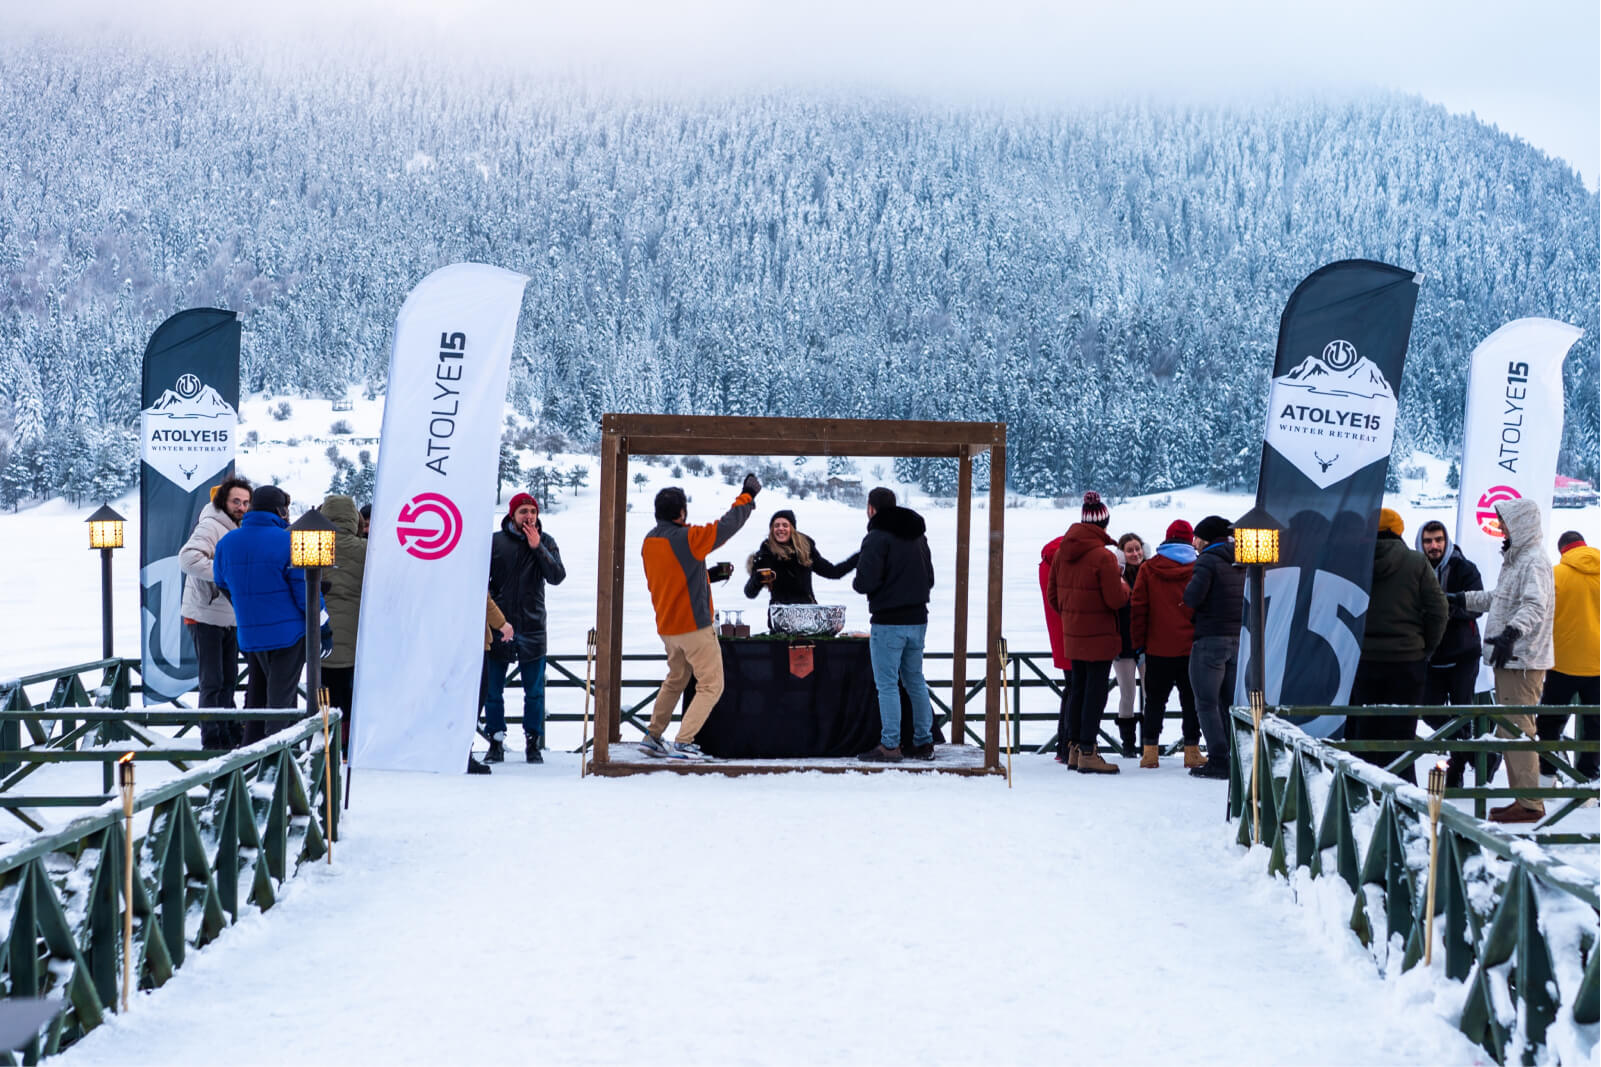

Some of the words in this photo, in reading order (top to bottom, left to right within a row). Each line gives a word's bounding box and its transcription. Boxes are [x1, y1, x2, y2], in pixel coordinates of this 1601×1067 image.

[426, 331, 466, 476] ATOLYE15
[1499, 361, 1529, 473] ATOLYE15
[1280, 404, 1381, 431] ATOLYE15
[152, 430, 228, 442] ATOLYE15
[1280, 424, 1324, 436] WINTER
[1329, 430, 1377, 443] RETREAT
